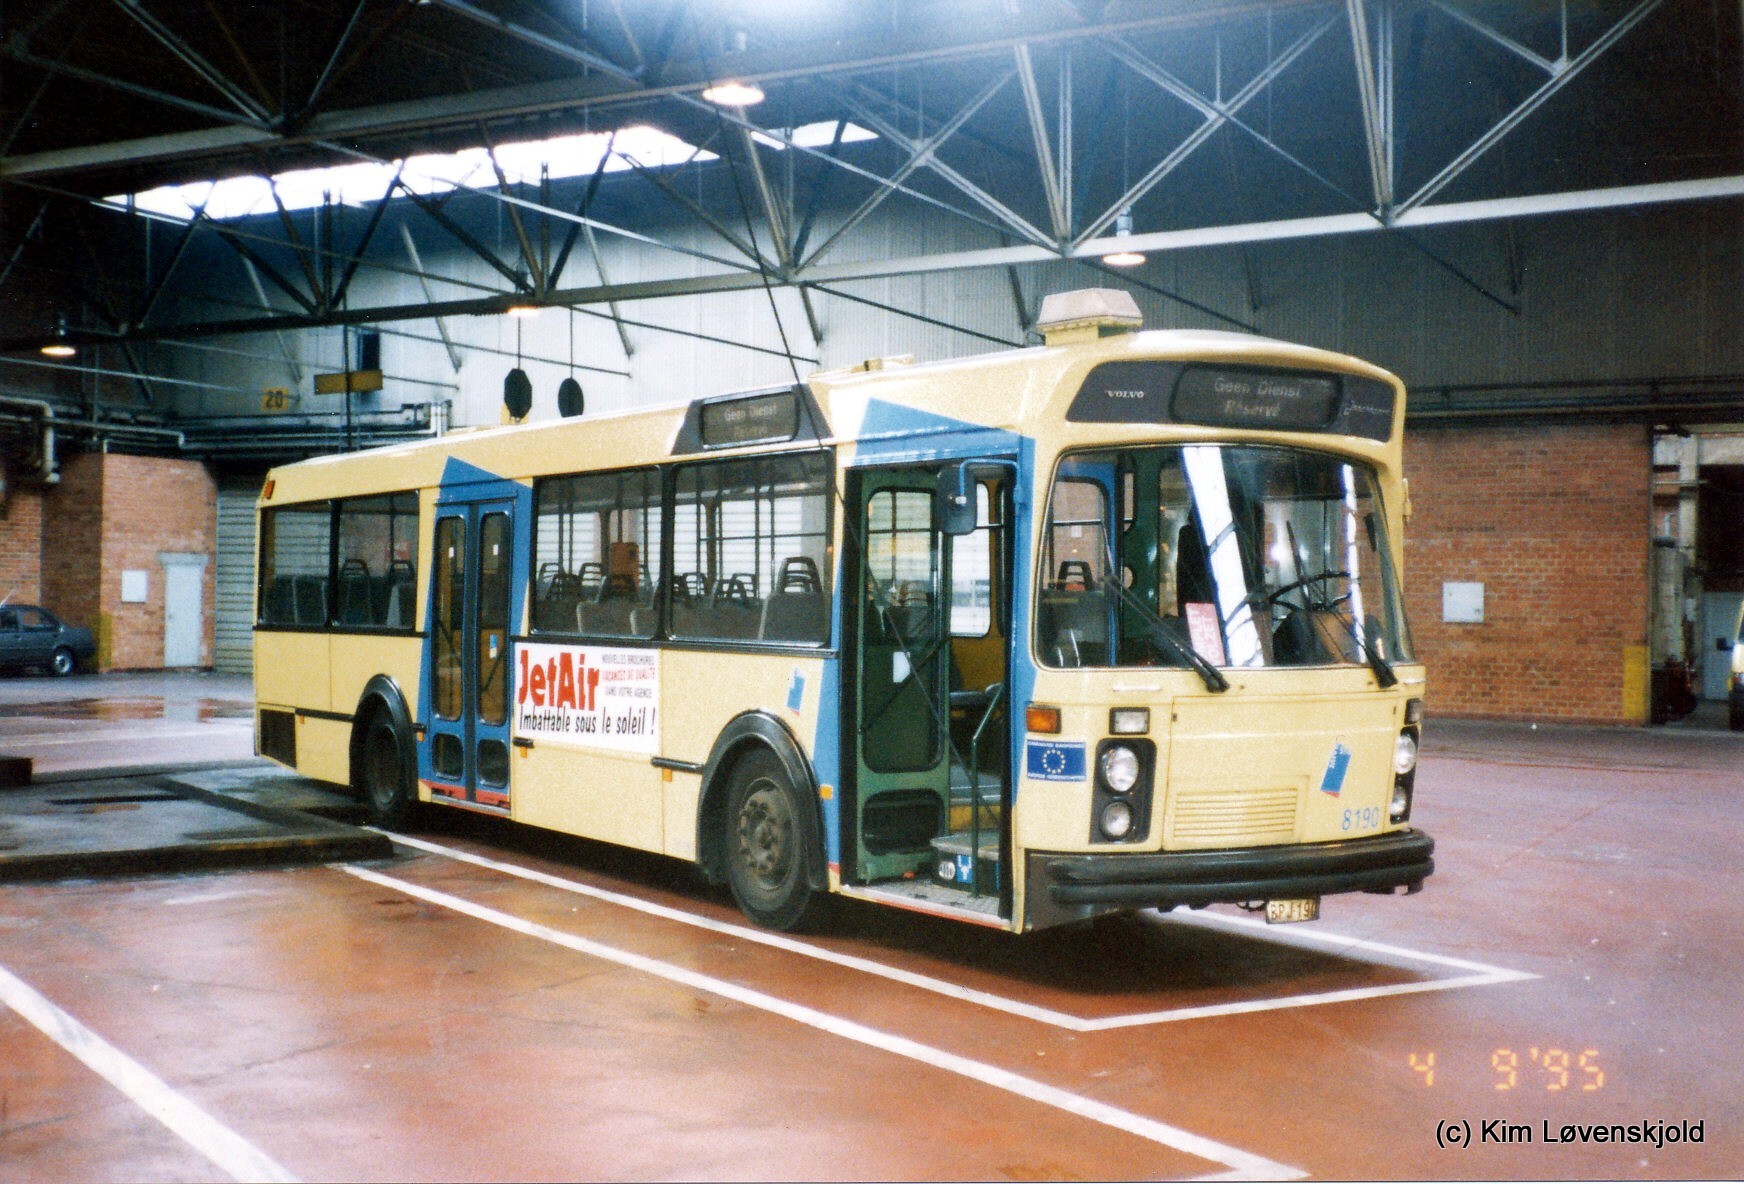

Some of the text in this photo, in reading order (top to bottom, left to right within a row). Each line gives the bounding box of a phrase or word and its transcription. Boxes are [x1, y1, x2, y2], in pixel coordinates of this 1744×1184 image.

[265, 389, 283, 409] 20
[1105, 389, 1145, 399] VOLVO
[518, 649, 600, 711] JetAir
[519, 703, 571, 732] Imbattable
[575, 714, 597, 733] sous
[601, 708, 612, 733] le
[616, 706, 646, 735] soleil
[1341, 806, 1380, 831] 8190
